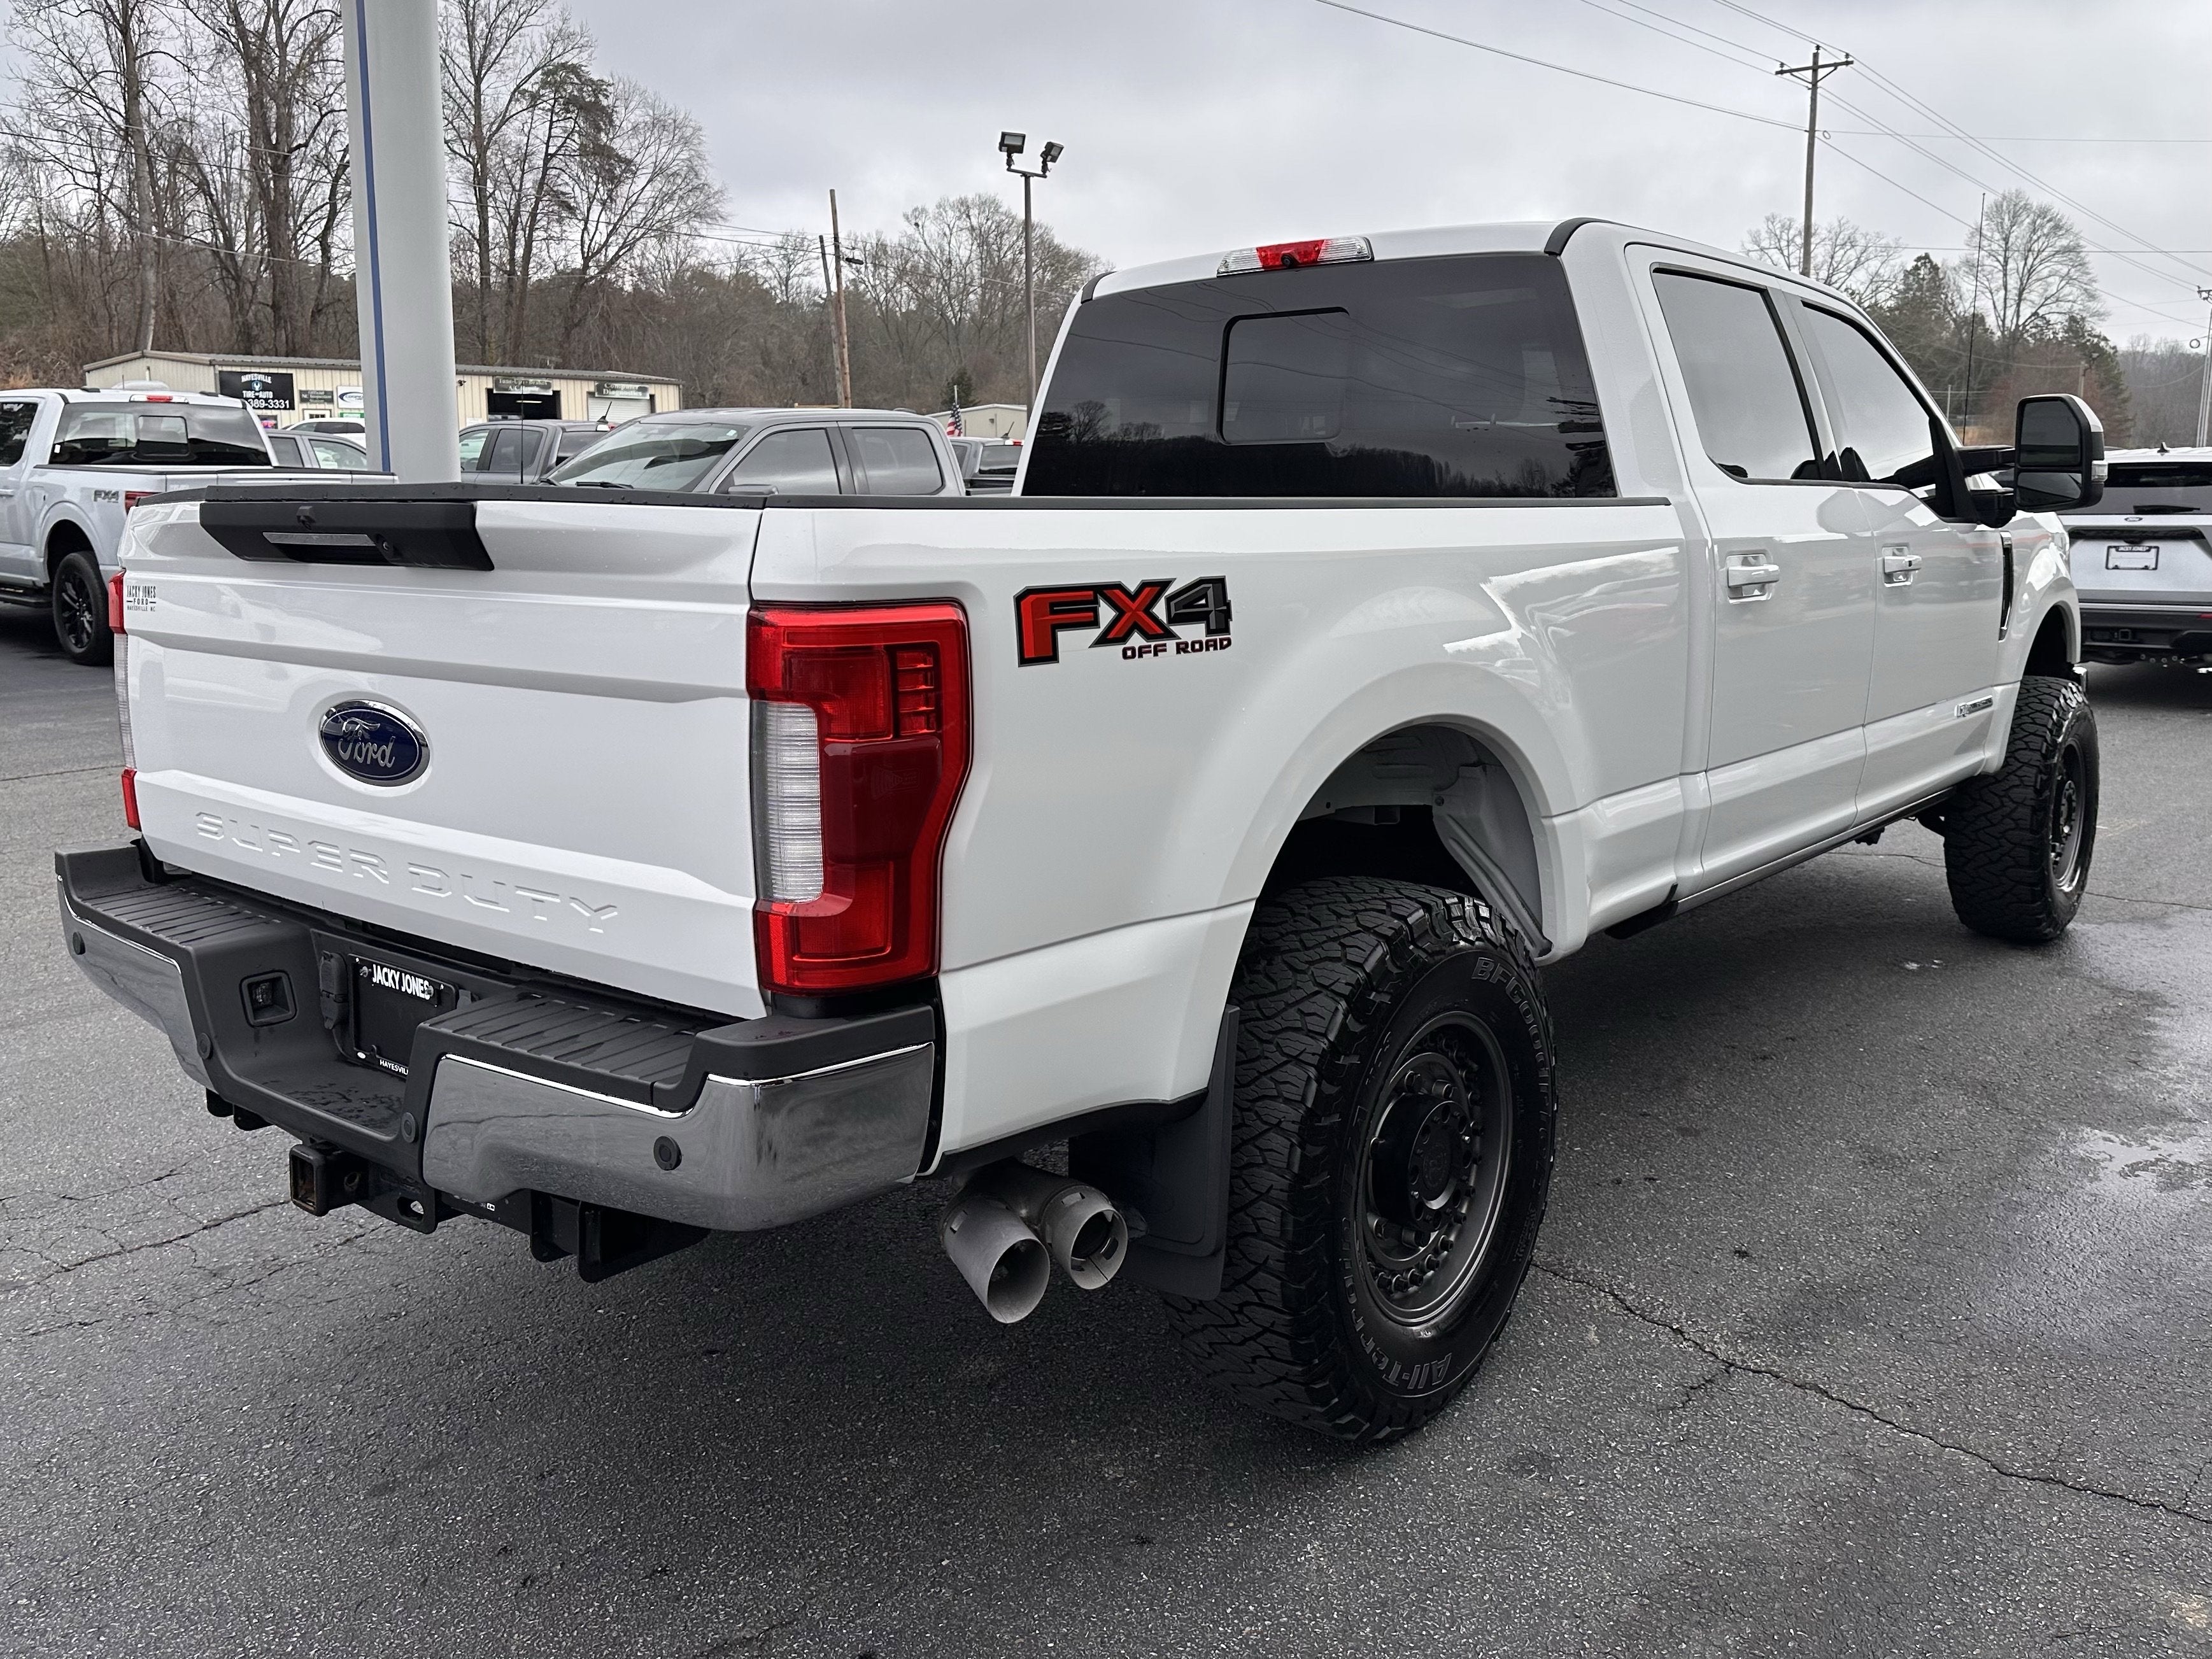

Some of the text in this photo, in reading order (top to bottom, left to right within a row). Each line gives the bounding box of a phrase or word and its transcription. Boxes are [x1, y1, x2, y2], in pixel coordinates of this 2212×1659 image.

[248, 399, 290, 409] 389-3331
[94, 490, 120, 502] FX4
[127, 585, 156, 598] JACKY JONES
[1013, 575, 1233, 667] FX4
[1121, 636, 1233, 661] OFF ROAD
[337, 717, 396, 768] Ford
[195, 811, 618, 934] SUPER DUTY
[372, 964, 431, 1000] JACKY JONES
